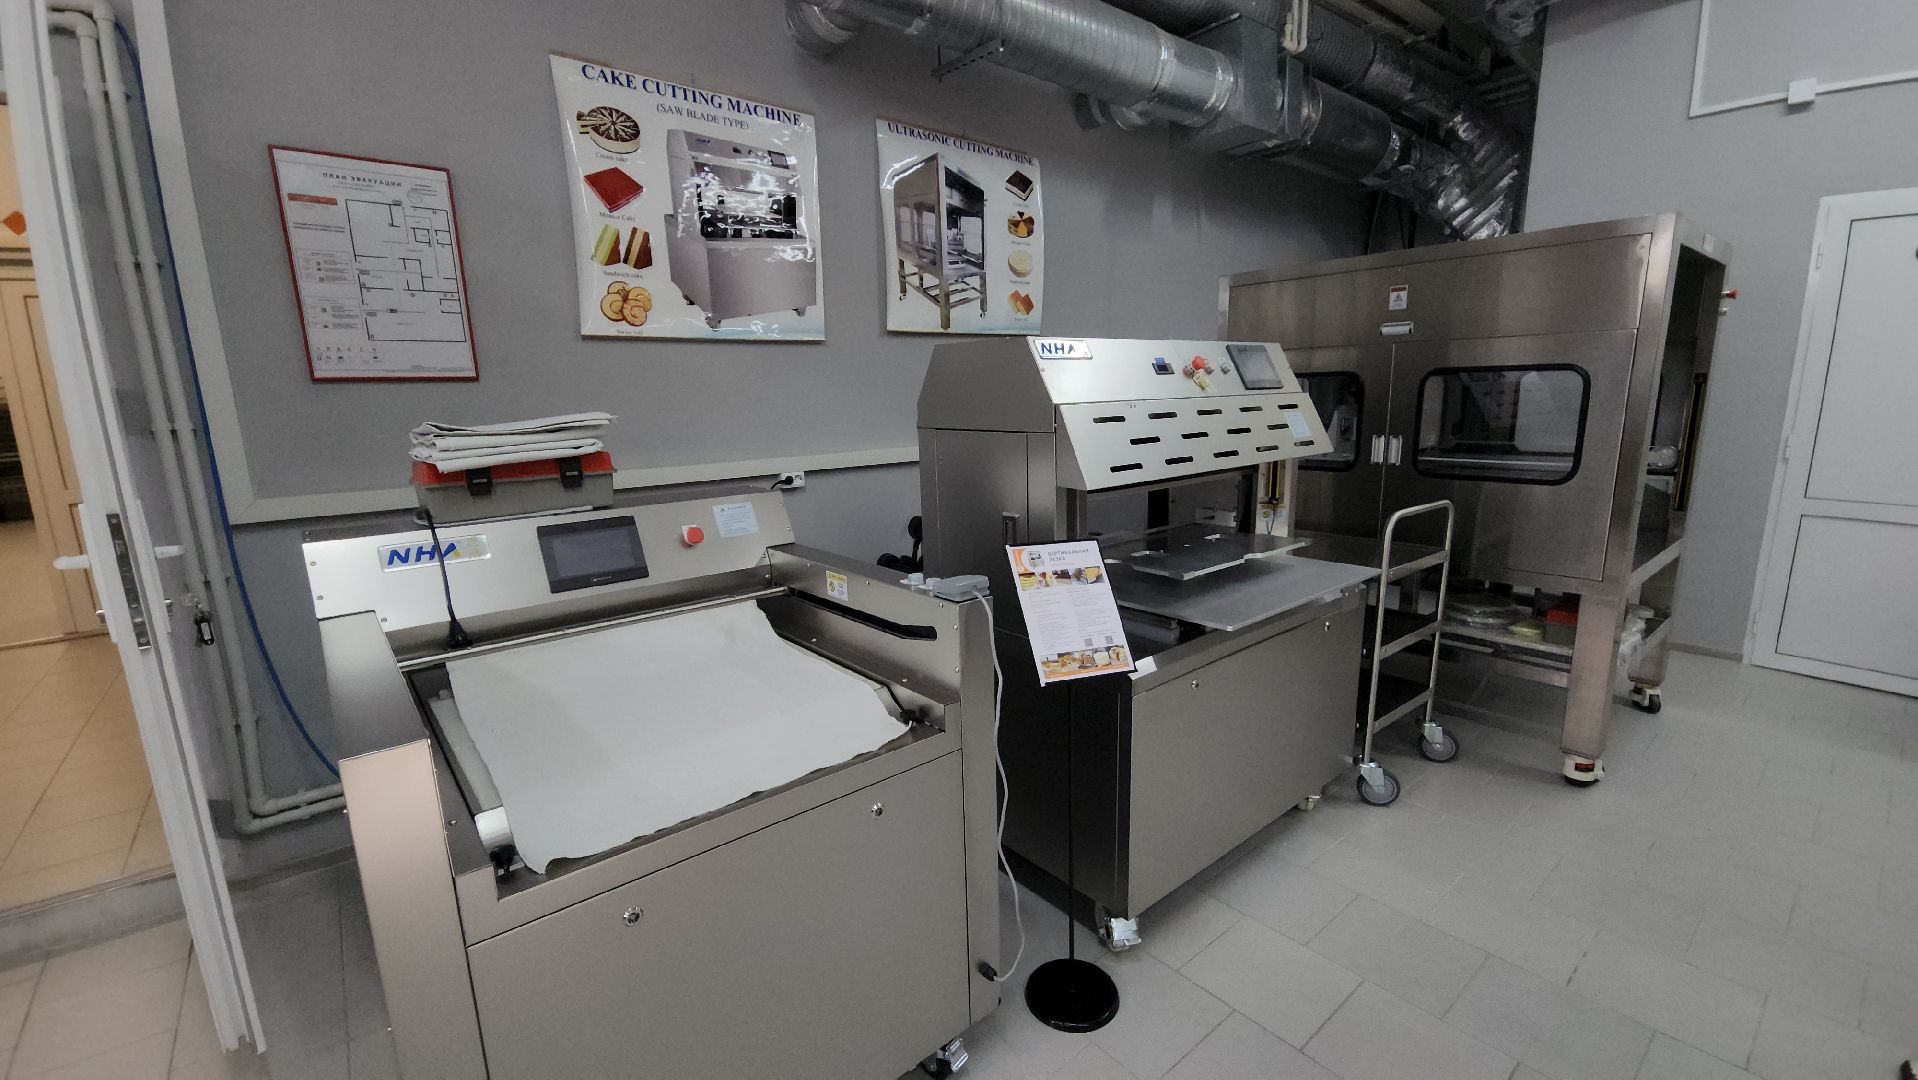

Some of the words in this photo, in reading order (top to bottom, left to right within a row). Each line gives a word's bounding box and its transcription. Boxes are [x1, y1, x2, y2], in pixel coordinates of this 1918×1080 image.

[581, 63, 637, 91] CAKE
[642, 78, 722, 109] CUTTING
[727, 97, 802, 127] MACHINE
[656, 103, 684, 117] (SAW
[686, 109, 719, 123] BLADE
[721, 116, 750, 131] TYPE)
[887, 122, 953, 146] ULTRASONIC
[953, 139, 994, 157] CUTTING
[994, 149, 1033, 166] MACHINE
[322, 171, 347, 181] ПЛАН
[351, 175, 402, 188] ЭВАКУАЦИИ
